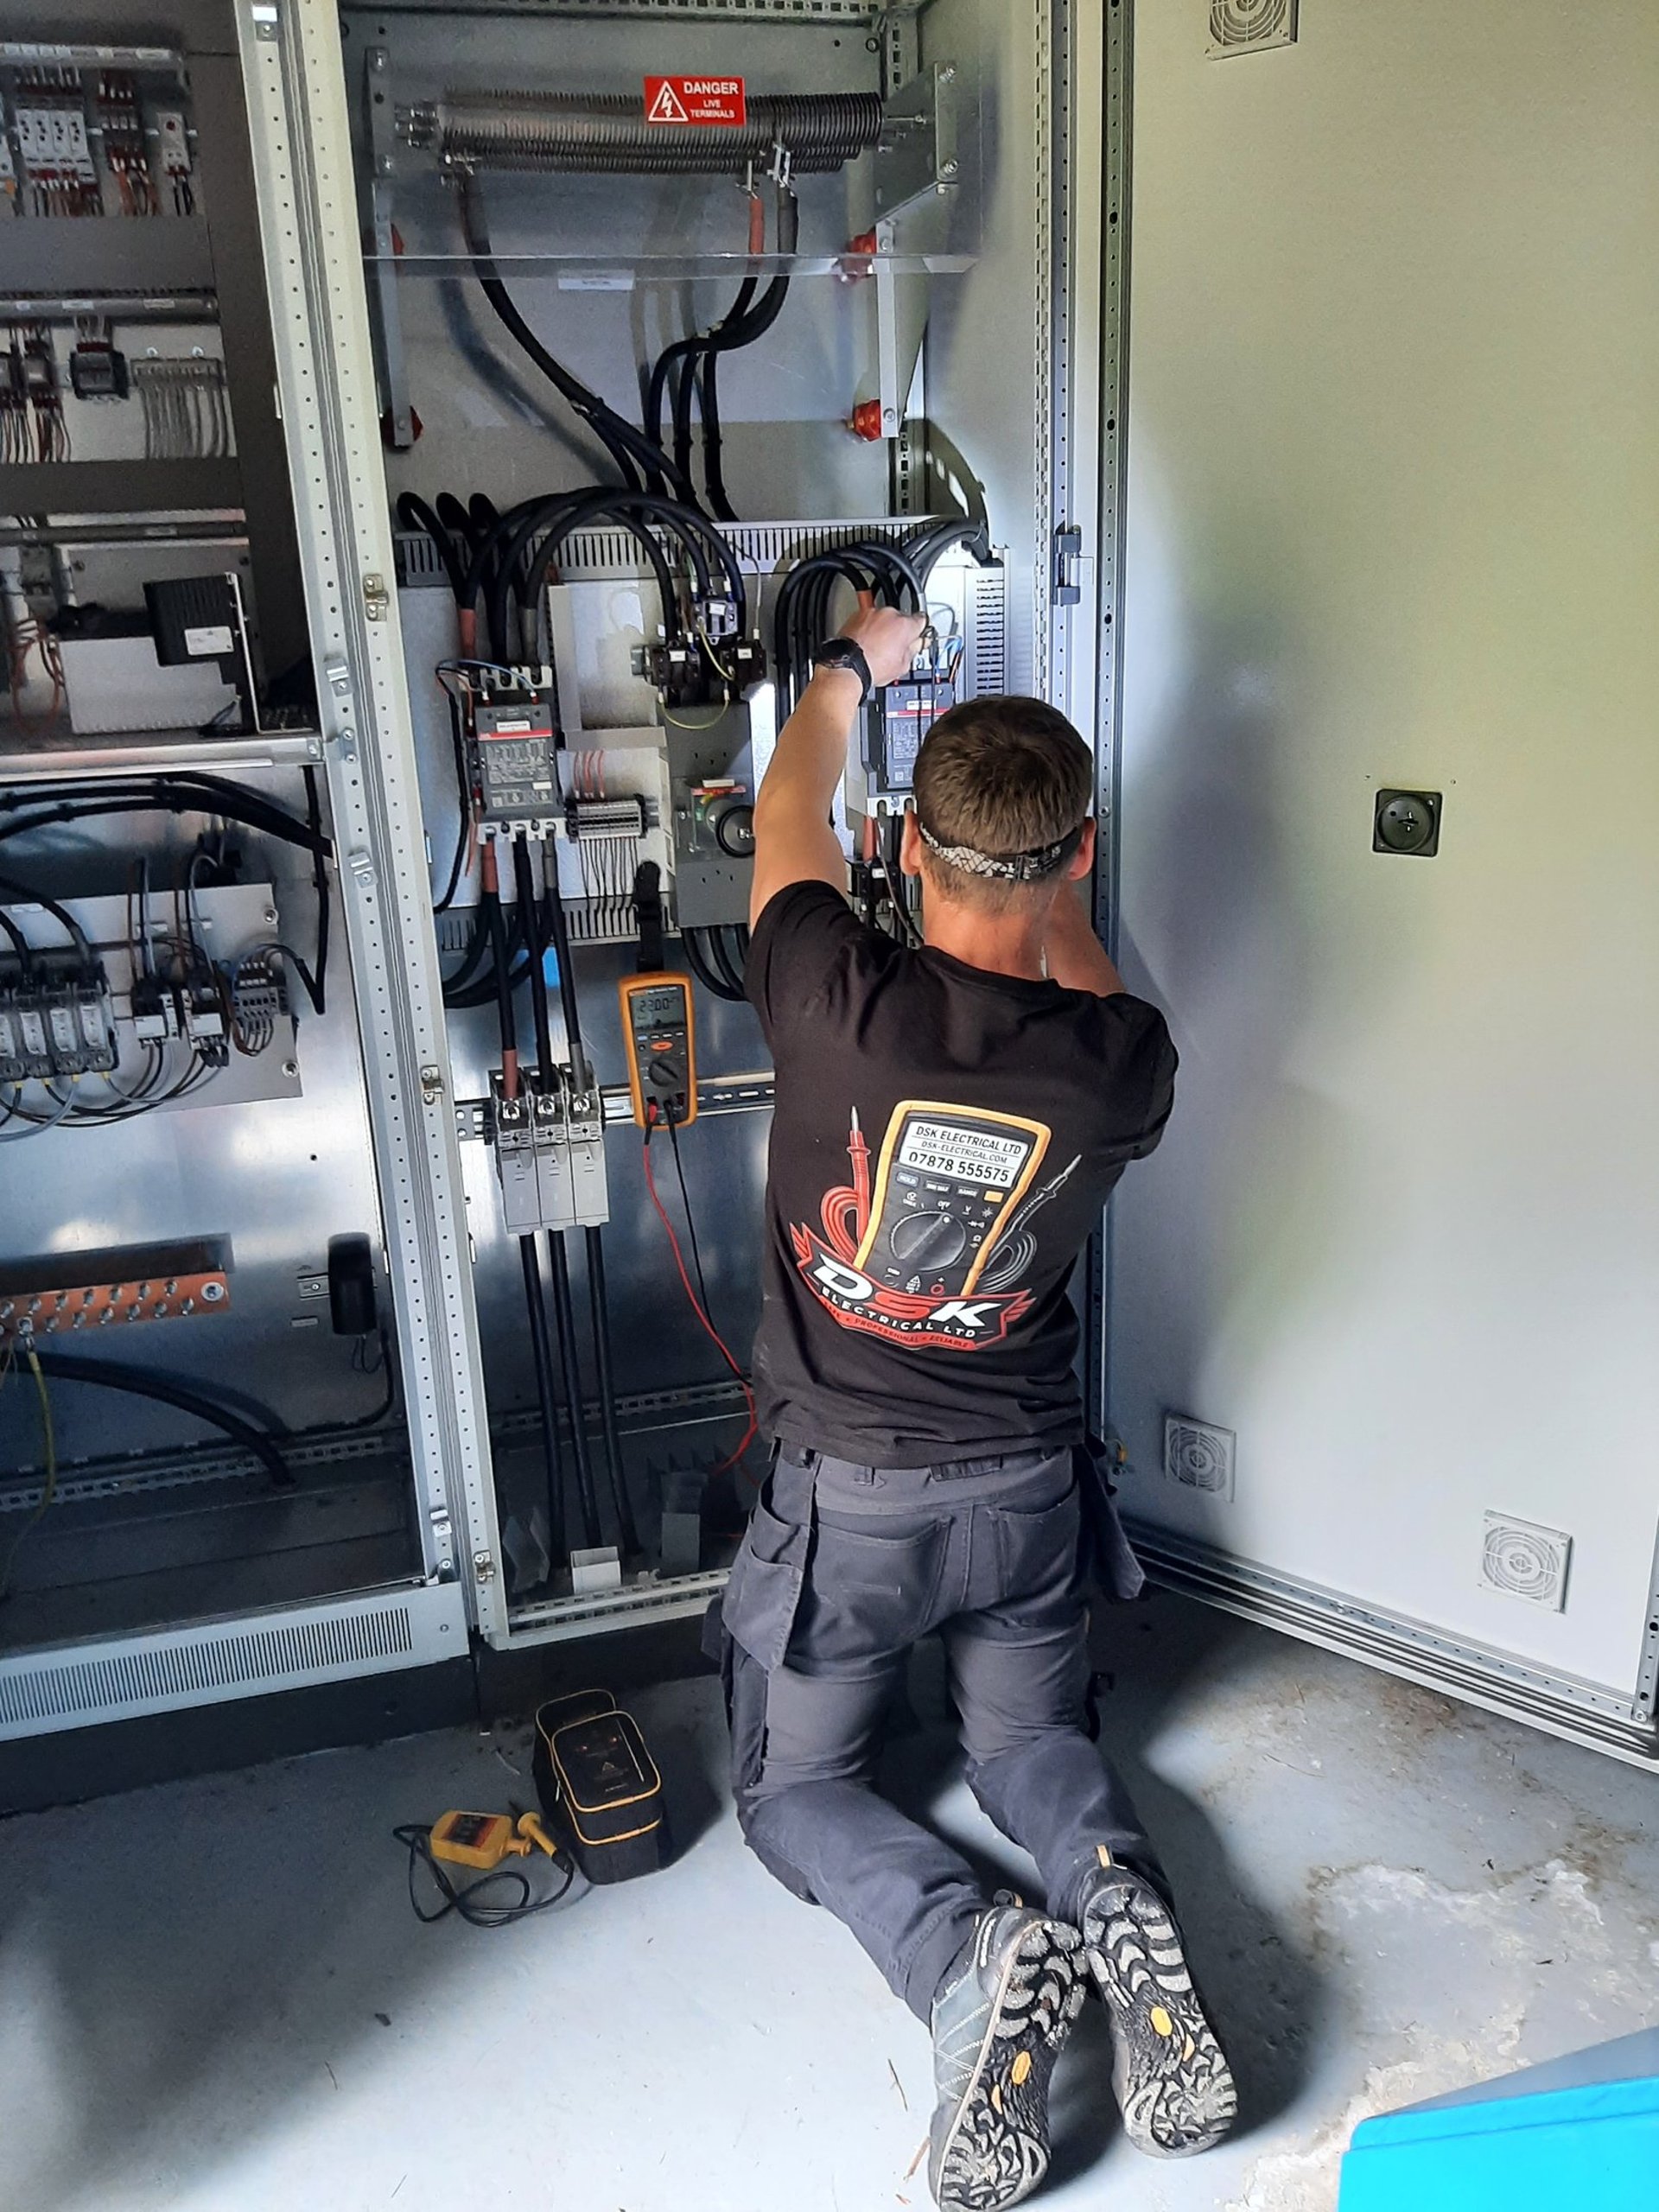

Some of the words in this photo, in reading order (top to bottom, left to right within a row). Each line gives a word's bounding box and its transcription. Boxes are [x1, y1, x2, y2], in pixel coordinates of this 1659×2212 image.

[683, 81, 739, 95] DANGER
[690, 109, 735, 118] TERMINALS
[703, 99, 721, 108] LIVE
[916, 1126, 938, 1139] DSK
[940, 1130, 1001, 1151] ELECTRICAL
[1002, 1142, 1021, 1154] LTD
[921, 1140, 1007, 1164] DSK-ELECTRICAL.COM
[908, 1151, 954, 1172] 07878
[957, 1160, 1010, 1182] 555575
[813, 1251, 1002, 1327] DSK
[822, 1286, 934, 1332] ELECTRICAL
[944, 1325, 976, 1338] LTD
